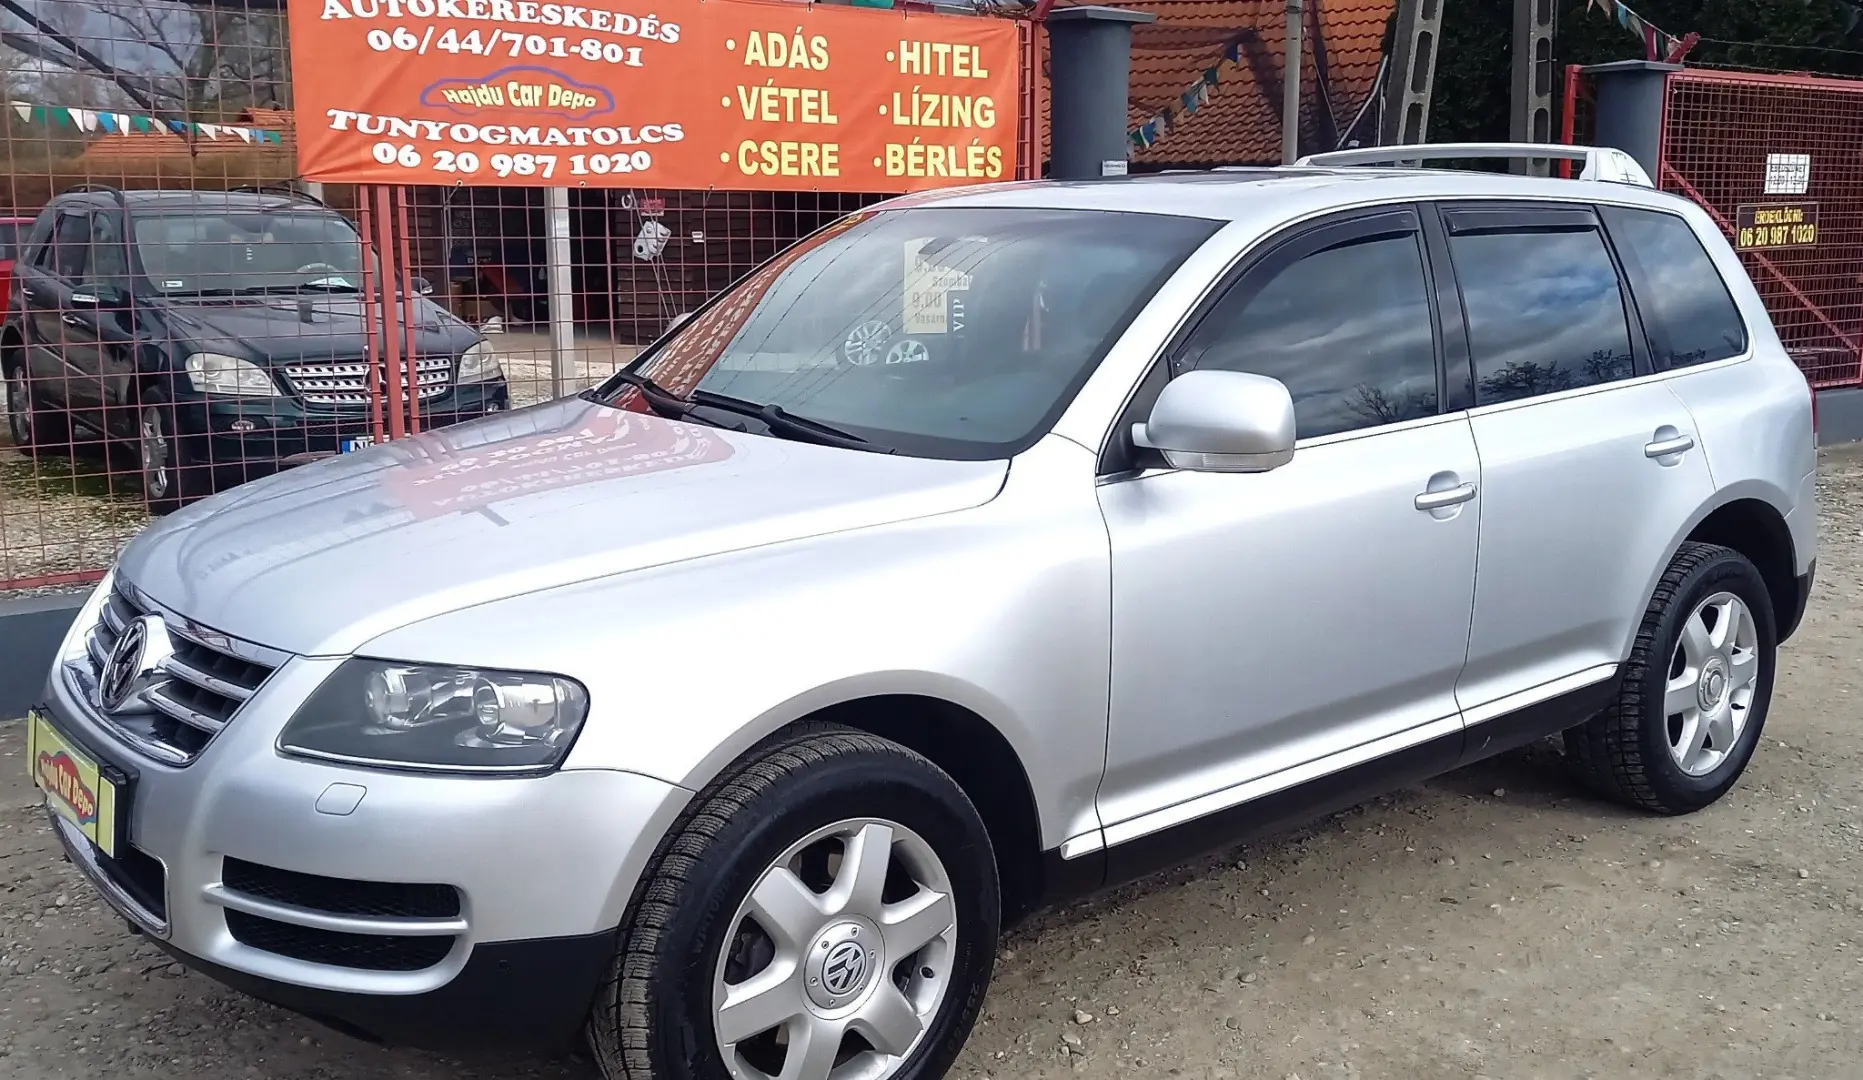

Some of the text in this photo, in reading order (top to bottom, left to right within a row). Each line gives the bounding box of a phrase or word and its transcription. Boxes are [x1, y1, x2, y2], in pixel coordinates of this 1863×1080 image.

[367, 25, 643, 67] 06/44/701-801
[743, 26, 829, 71] ADÁS
[899, 40, 988, 79] HITEL
[441, 81, 597, 110] Hajdu Car Depo
[736, 78, 838, 125] VÉTEL
[893, 85, 996, 129] LÍZING
[326, 108, 685, 147] TUNYOGMATOLCS
[372, 142, 651, 179] 06 20 987 1020
[738, 139, 840, 177] CSERE
[885, 136, 1002, 178] BÉRLÉS
[1741, 224, 1814, 246] 06 20 987 1020
[952, 298, 965, 333] VIP
